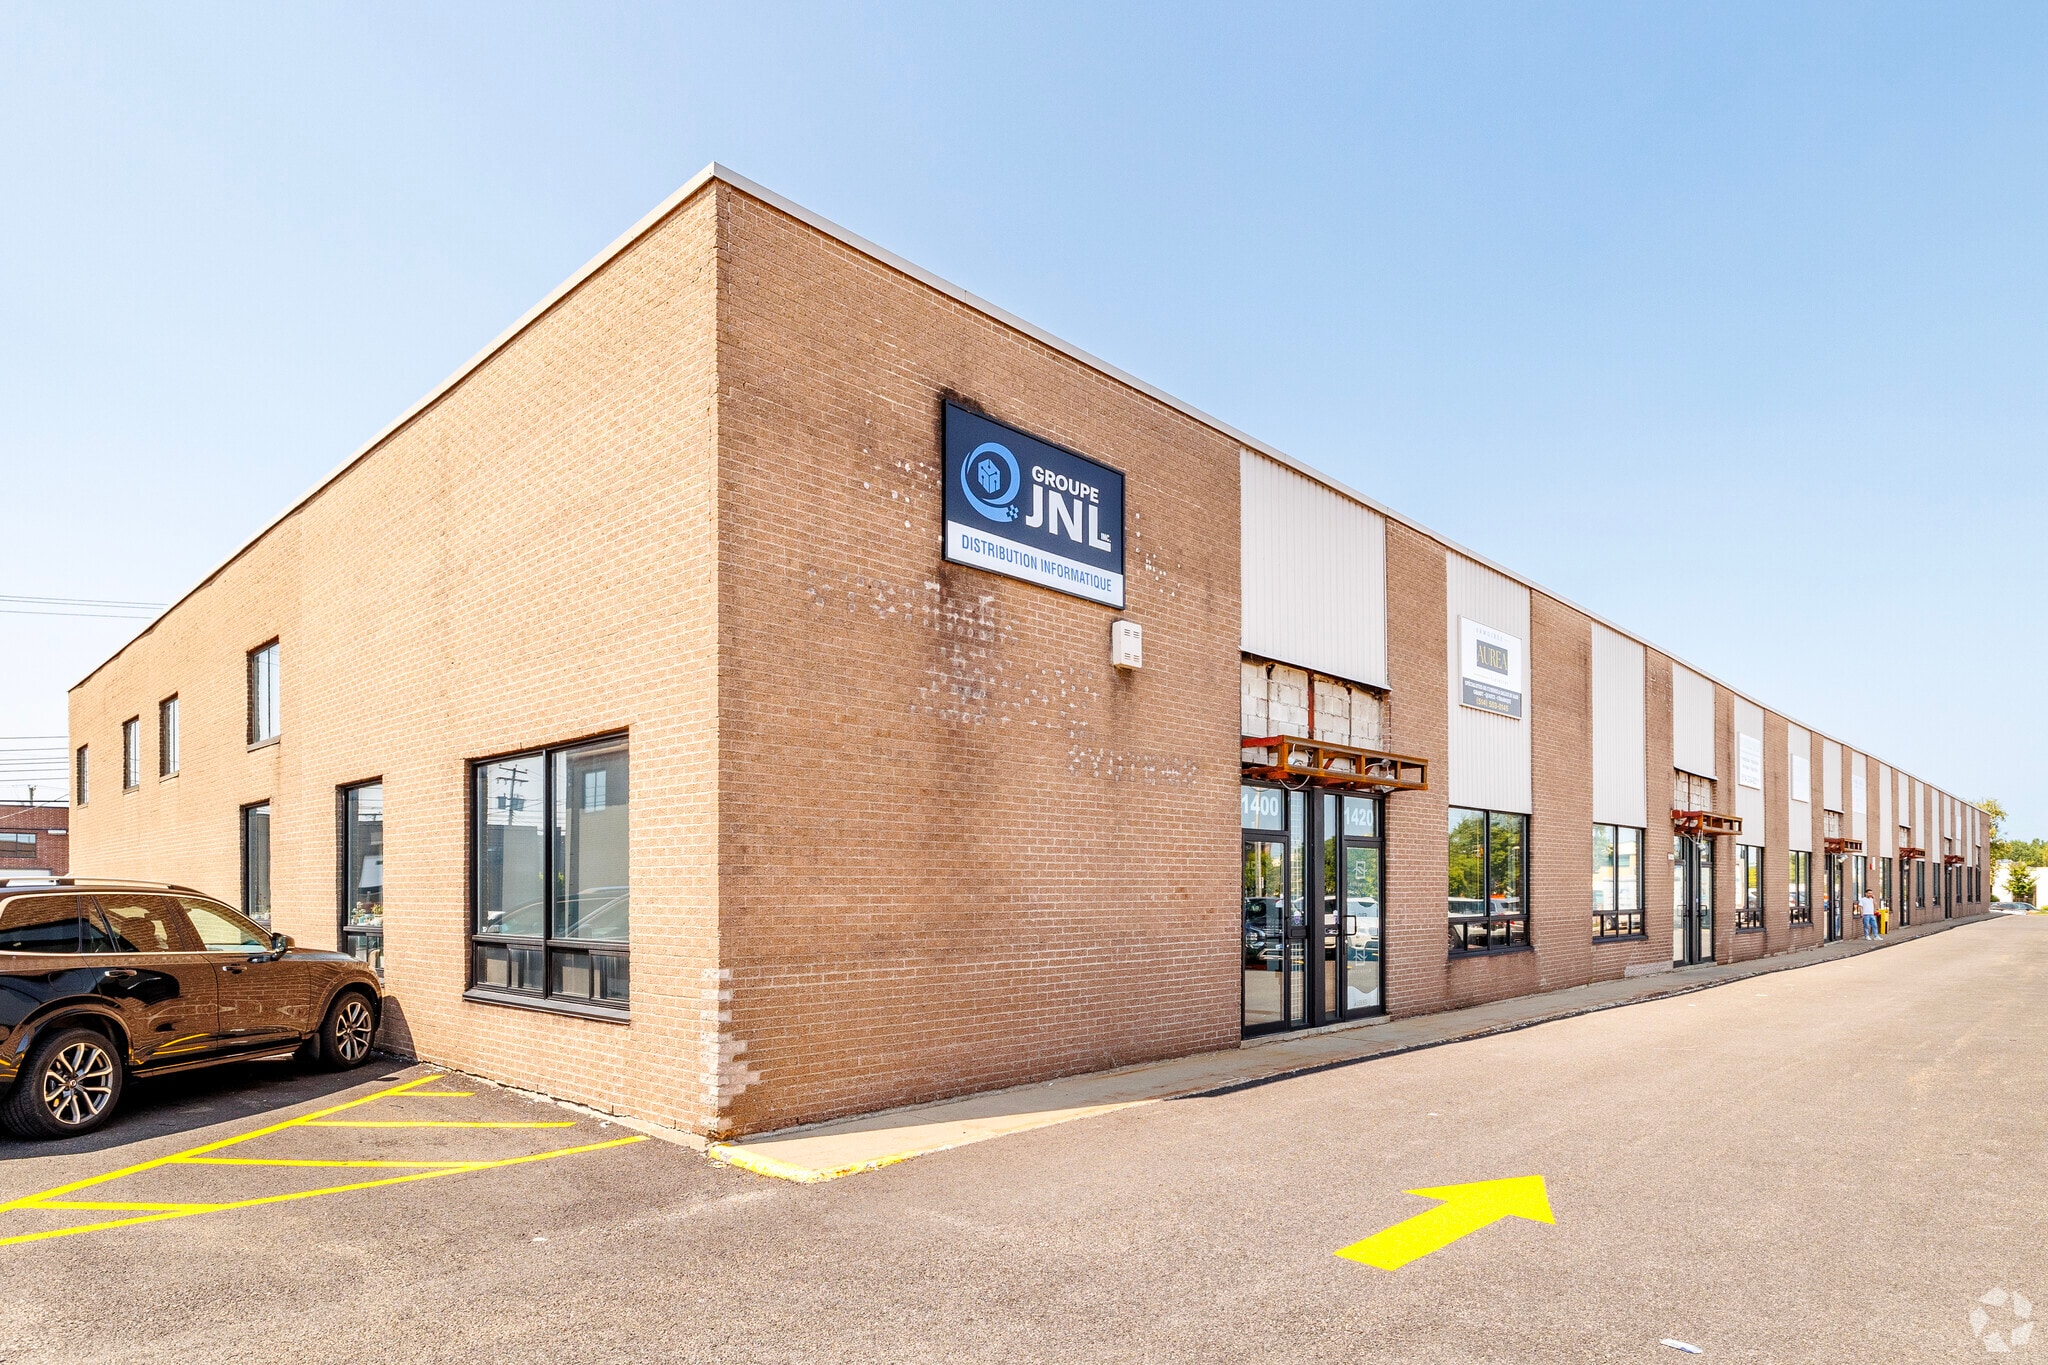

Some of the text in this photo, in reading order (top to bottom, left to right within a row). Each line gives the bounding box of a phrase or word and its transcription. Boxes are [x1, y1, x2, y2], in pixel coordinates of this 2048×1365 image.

[1031, 465, 1099, 504] GROUPE
[1025, 483, 1112, 553] JNL
[961, 534, 1112, 592] DISTRIBUTION INFORMATIQUE
[1477, 644, 1508, 671] AUREA
[1241, 793, 1279, 817] 1400
[1344, 806, 1374, 827] 1420
